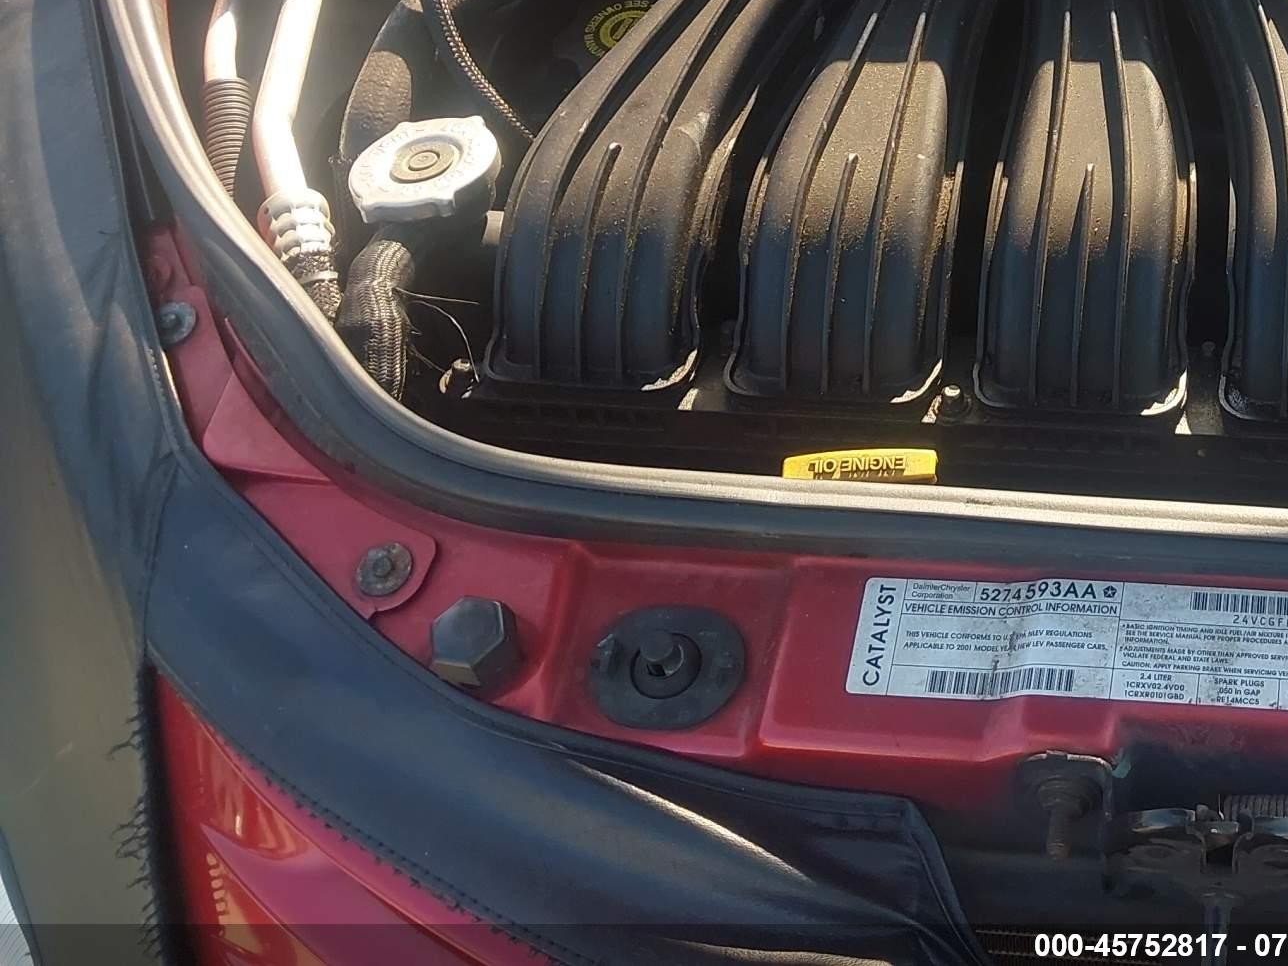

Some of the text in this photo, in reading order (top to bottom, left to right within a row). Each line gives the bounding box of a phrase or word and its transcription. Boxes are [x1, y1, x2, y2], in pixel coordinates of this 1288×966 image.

[624, 0, 649, 8] SEE
[808, 455, 906, 473] ENGINE OIL
[912, 582, 971, 593] DaimlerChrysler
[980, 581, 1097, 602] 5274593AA
[911, 591, 953, 600] Corporation
[904, 602, 1118, 616] VEHICLE EMISSION CONTROL INFORMATION
[862, 584, 897, 686] CATALYST
[906, 630, 920, 638] THIS
[921, 631, 949, 639] VEHICLE
[1045, 629, 1092, 639] REGULATIONS
[1258, 631, 1284, 639] MIXTURE
[903, 642, 944, 650] APPLICABLE
[1032, 640, 1044, 648] LEV
[1046, 640, 1085, 649] PASSENGER
[1242, 637, 1282, 645] PROCEDURES
[1236, 652, 1269, 660] APPROVED
[1243, 668, 1277, 676] SERVICING
[1214, 677, 1265, 687] SPARK PLUGS
